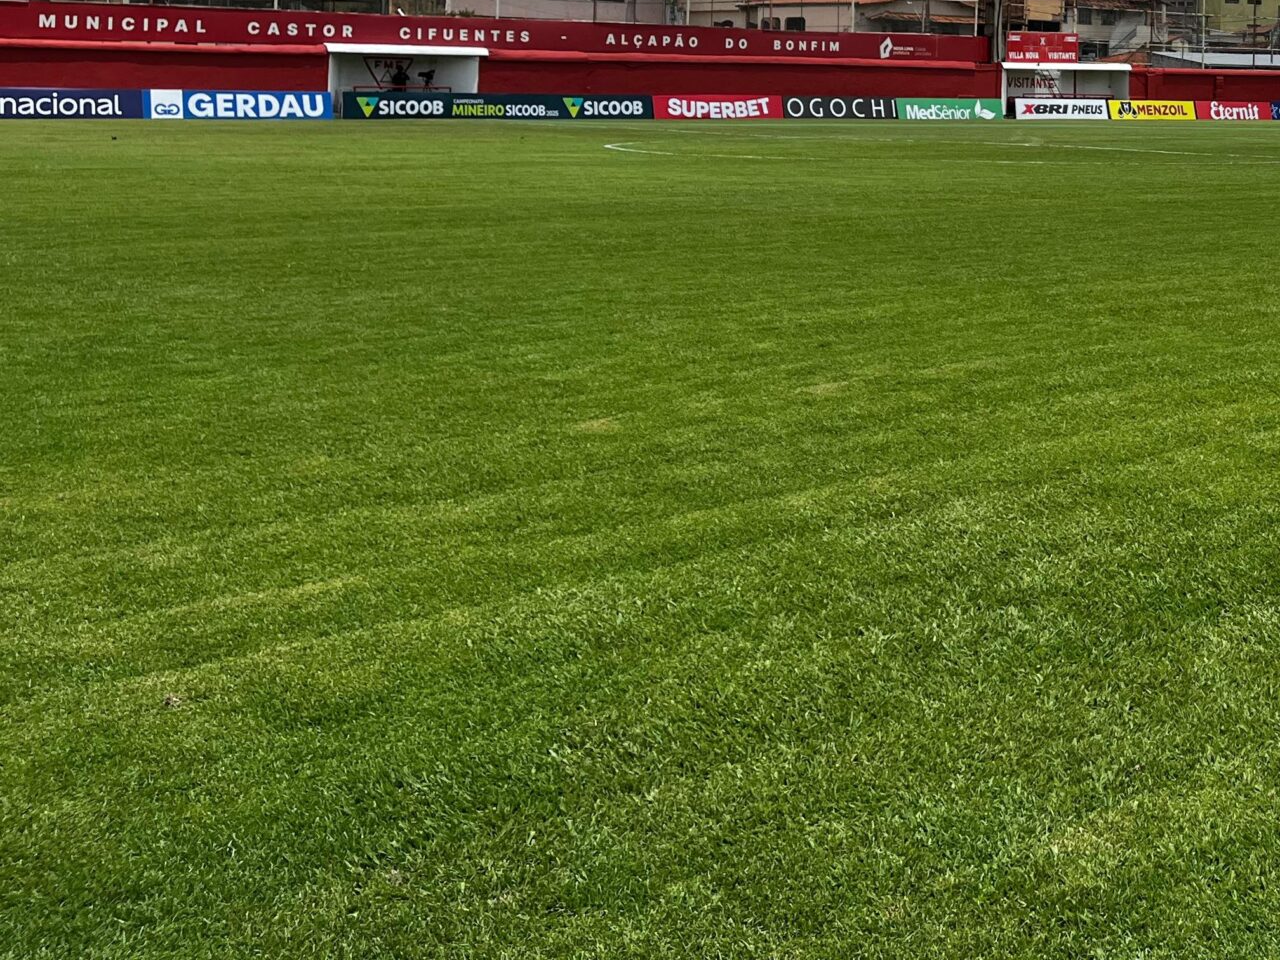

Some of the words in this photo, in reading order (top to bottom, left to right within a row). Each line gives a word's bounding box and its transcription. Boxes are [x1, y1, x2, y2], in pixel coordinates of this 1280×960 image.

[39, 13, 206, 34] MUNICIPAL
[247, 21, 354, 38] CASTOR
[400, 27, 530, 43] CIFUENTES
[605, 33, 698, 49] ALÇAPÃO
[725, 38, 748, 50] DO
[773, 40, 840, 52] BONFIM
[1008, 51, 1024, 60] VILLA
[1025, 52, 1039, 60] NOVA
[1048, 52, 1076, 60] VISITANTE
[1007, 76, 1055, 89] VISITANTE
[0, 92, 122, 116] nacional
[187, 93, 324, 118] GERDAU
[378, 99, 444, 116] SICOOB
[452, 104, 504, 117] MINEIRO
[505, 104, 546, 117] SICOOB
[583, 100, 643, 116] SICOOB
[667, 97, 770, 119] SUPERBET
[787, 97, 896, 118] OGOCHI
[1022, 103, 1068, 115] XBRI
[1071, 104, 1103, 115] PNEUS
[1137, 104, 1188, 116] MENZOIL
[1210, 101, 1259, 120] Eternit
[905, 105, 971, 120] MedSênior
